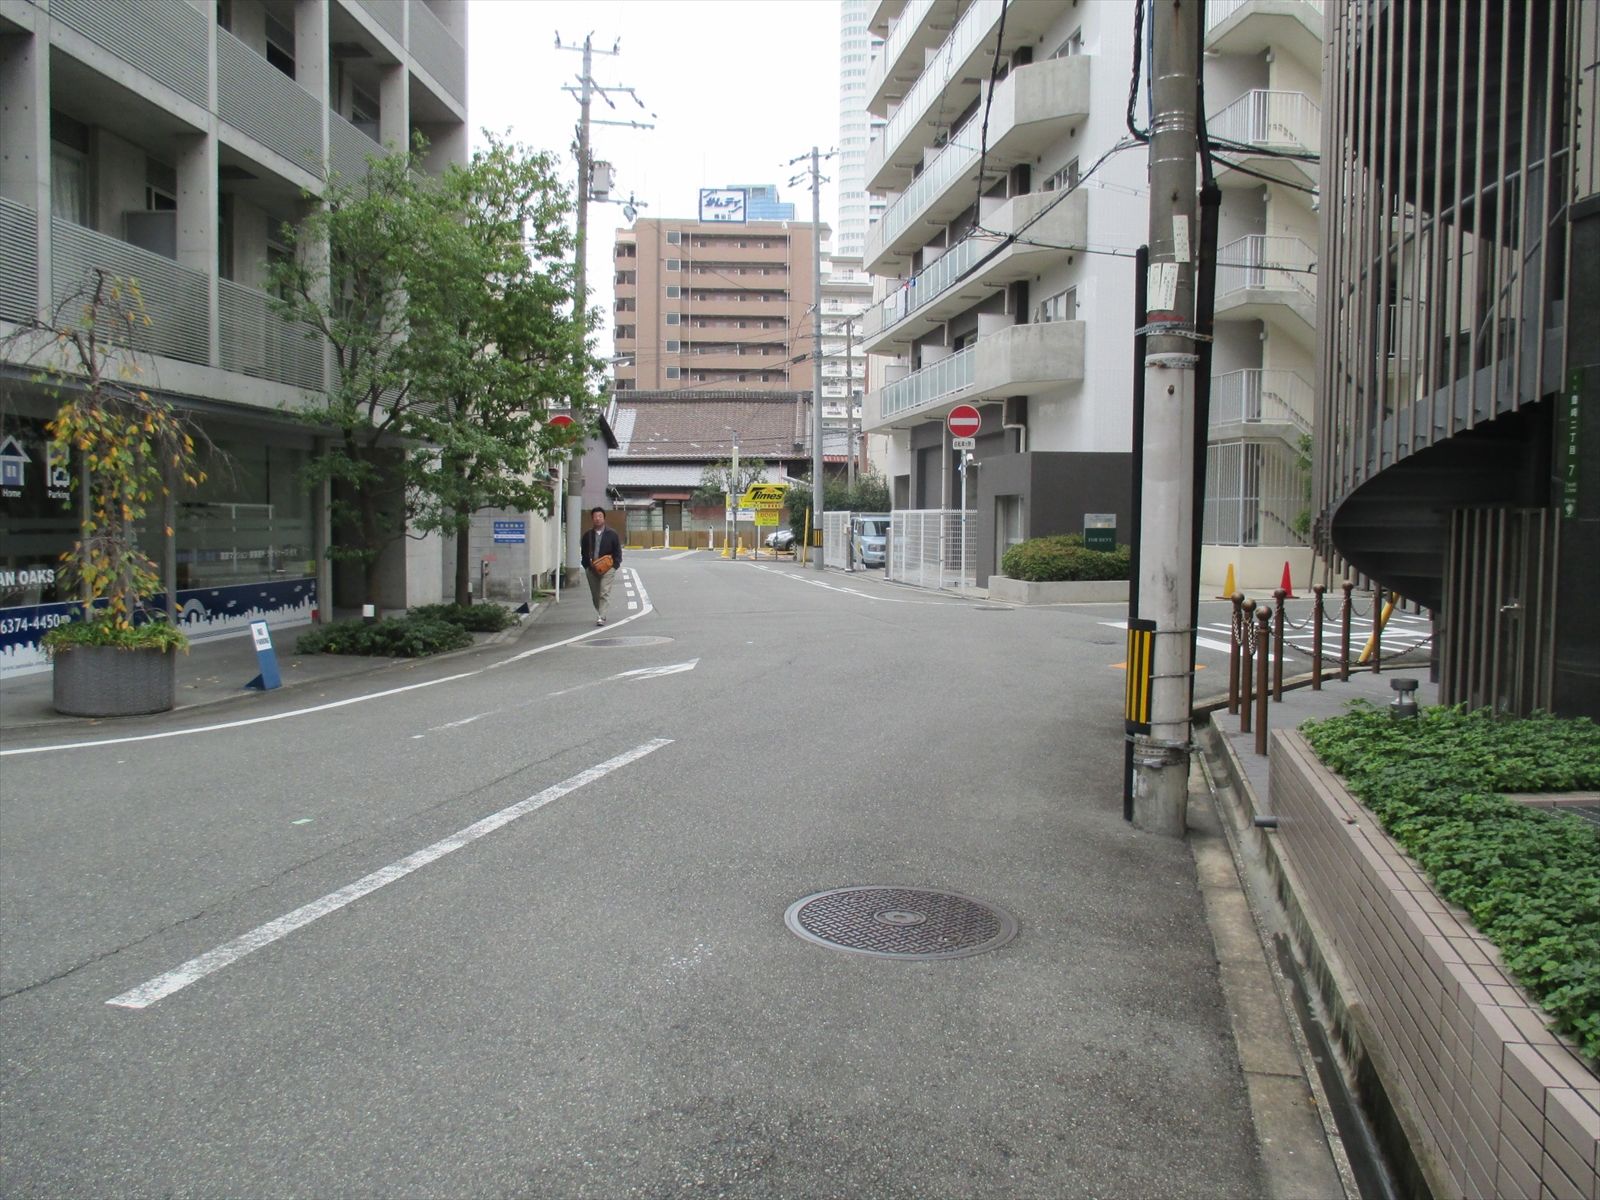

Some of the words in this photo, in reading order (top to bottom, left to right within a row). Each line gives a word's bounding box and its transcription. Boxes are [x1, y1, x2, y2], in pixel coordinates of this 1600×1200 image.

[2, 489, 22, 498] Home
[48, 490, 71, 501] Parking
[751, 489, 783, 501] Times
[19, 569, 55, 585] OAKS
[0, 613, 60, 635] 6374-4450
